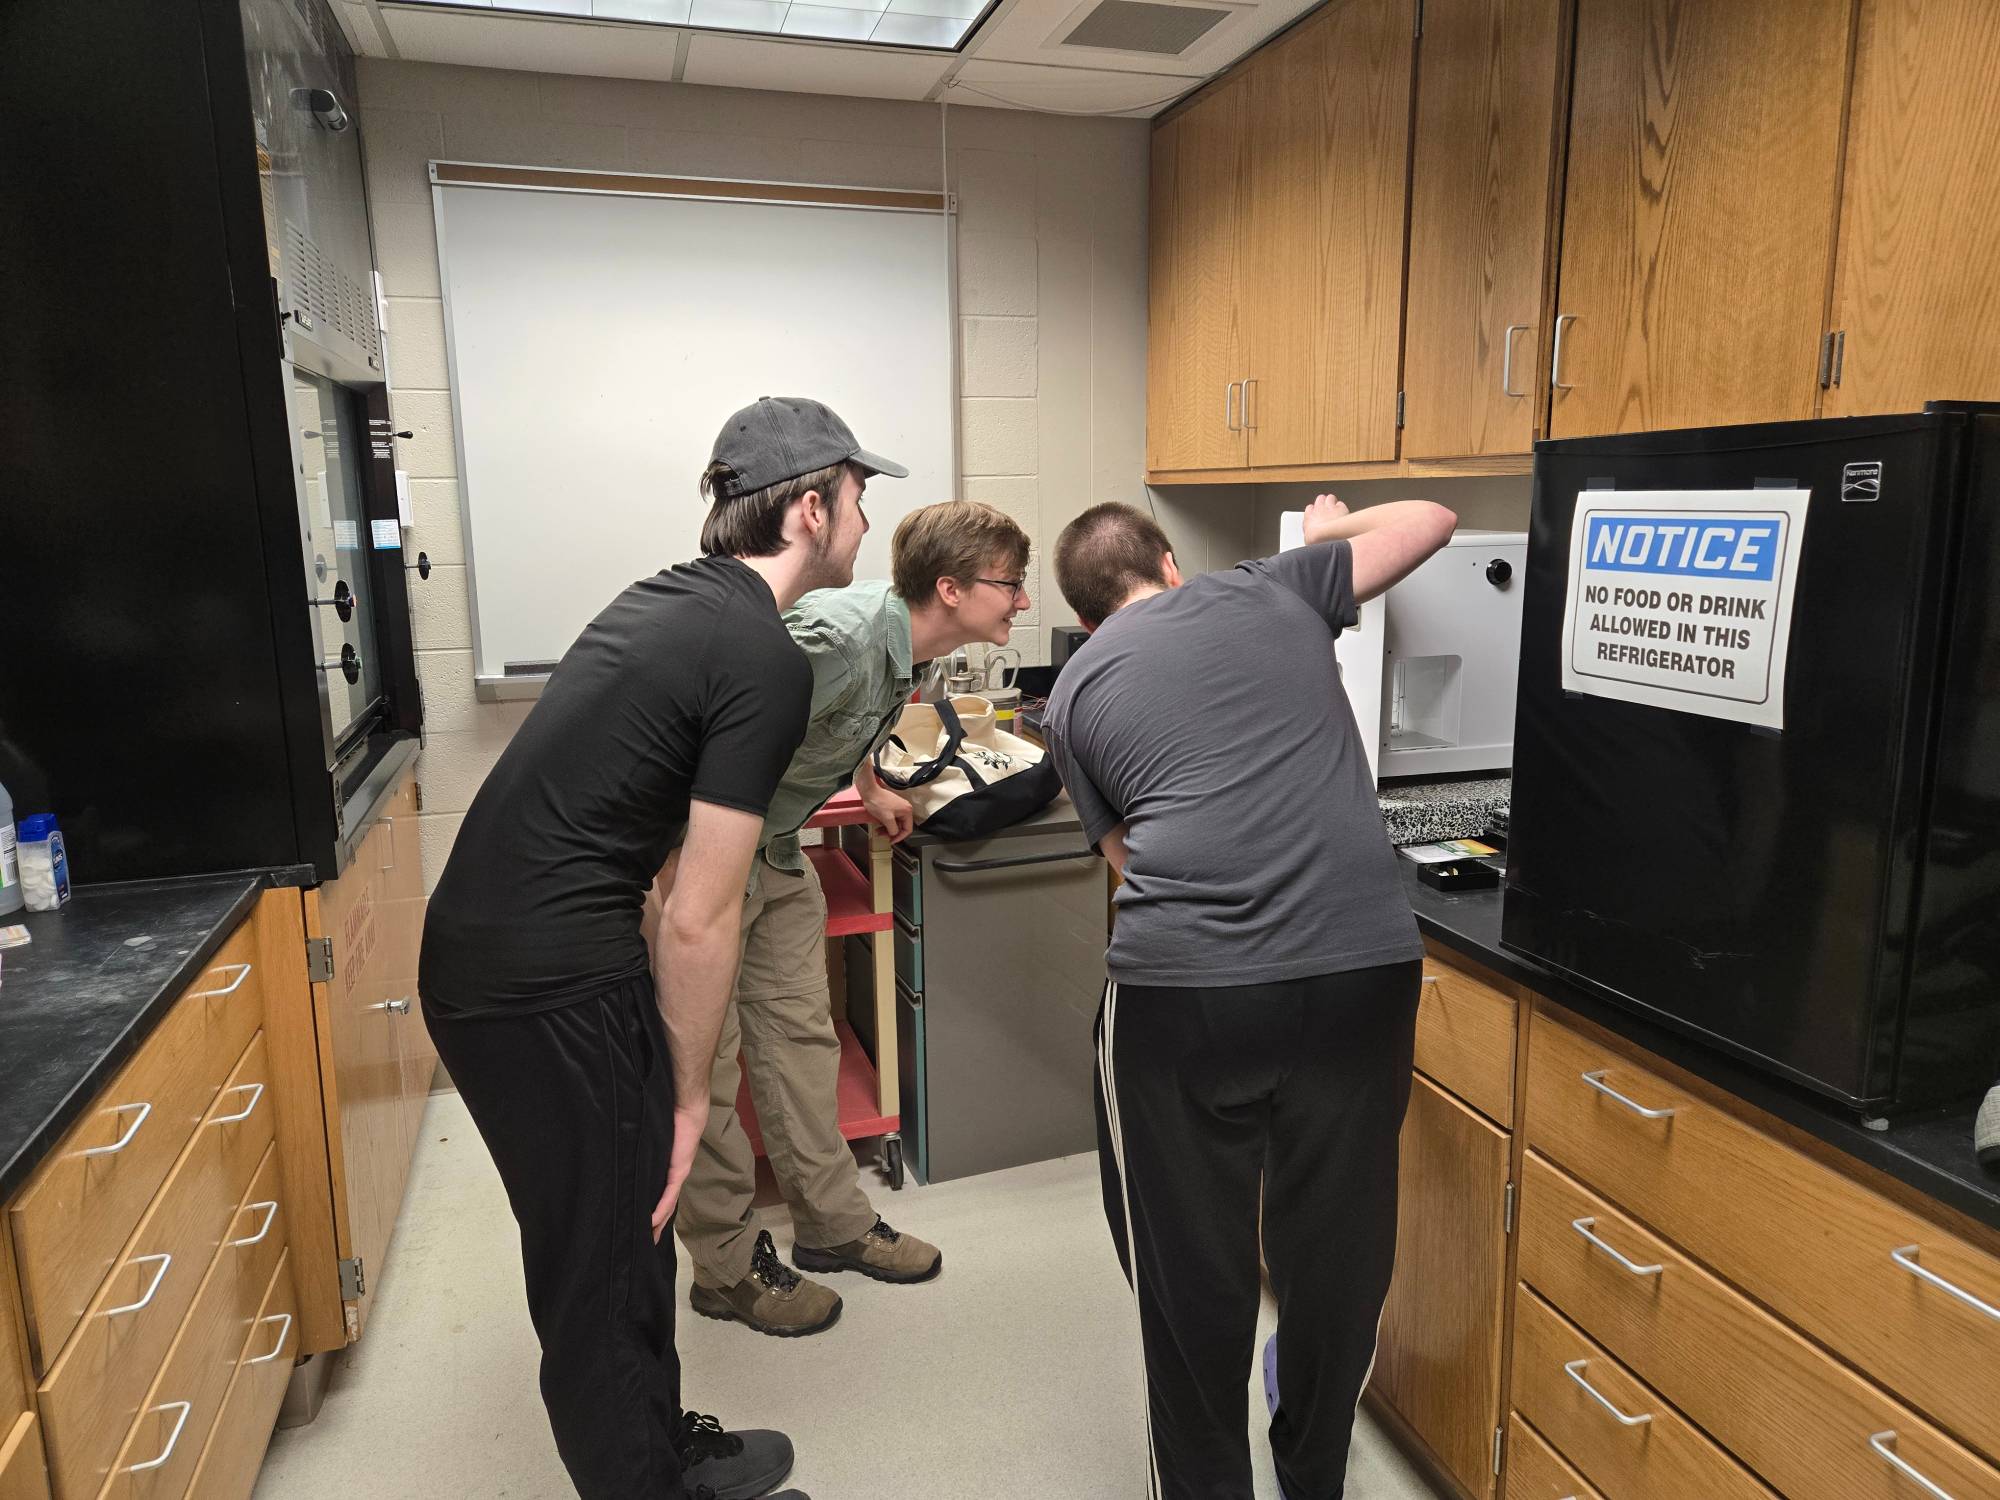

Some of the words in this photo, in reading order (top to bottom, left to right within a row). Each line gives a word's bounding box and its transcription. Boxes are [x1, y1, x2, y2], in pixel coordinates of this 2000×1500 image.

[1592, 525, 1771, 572] NOTICE
[1585, 585, 1609, 605] NO
[1614, 588, 1661, 609] FOOD
[1667, 592, 1692, 613] OR
[1699, 595, 1766, 620] DRINK
[1590, 614, 1670, 640] ALLOWED
[1677, 622, 1696, 643] IN
[1703, 626, 1750, 650] THIS
[1597, 642, 1735, 679] REFRIGERATOR
